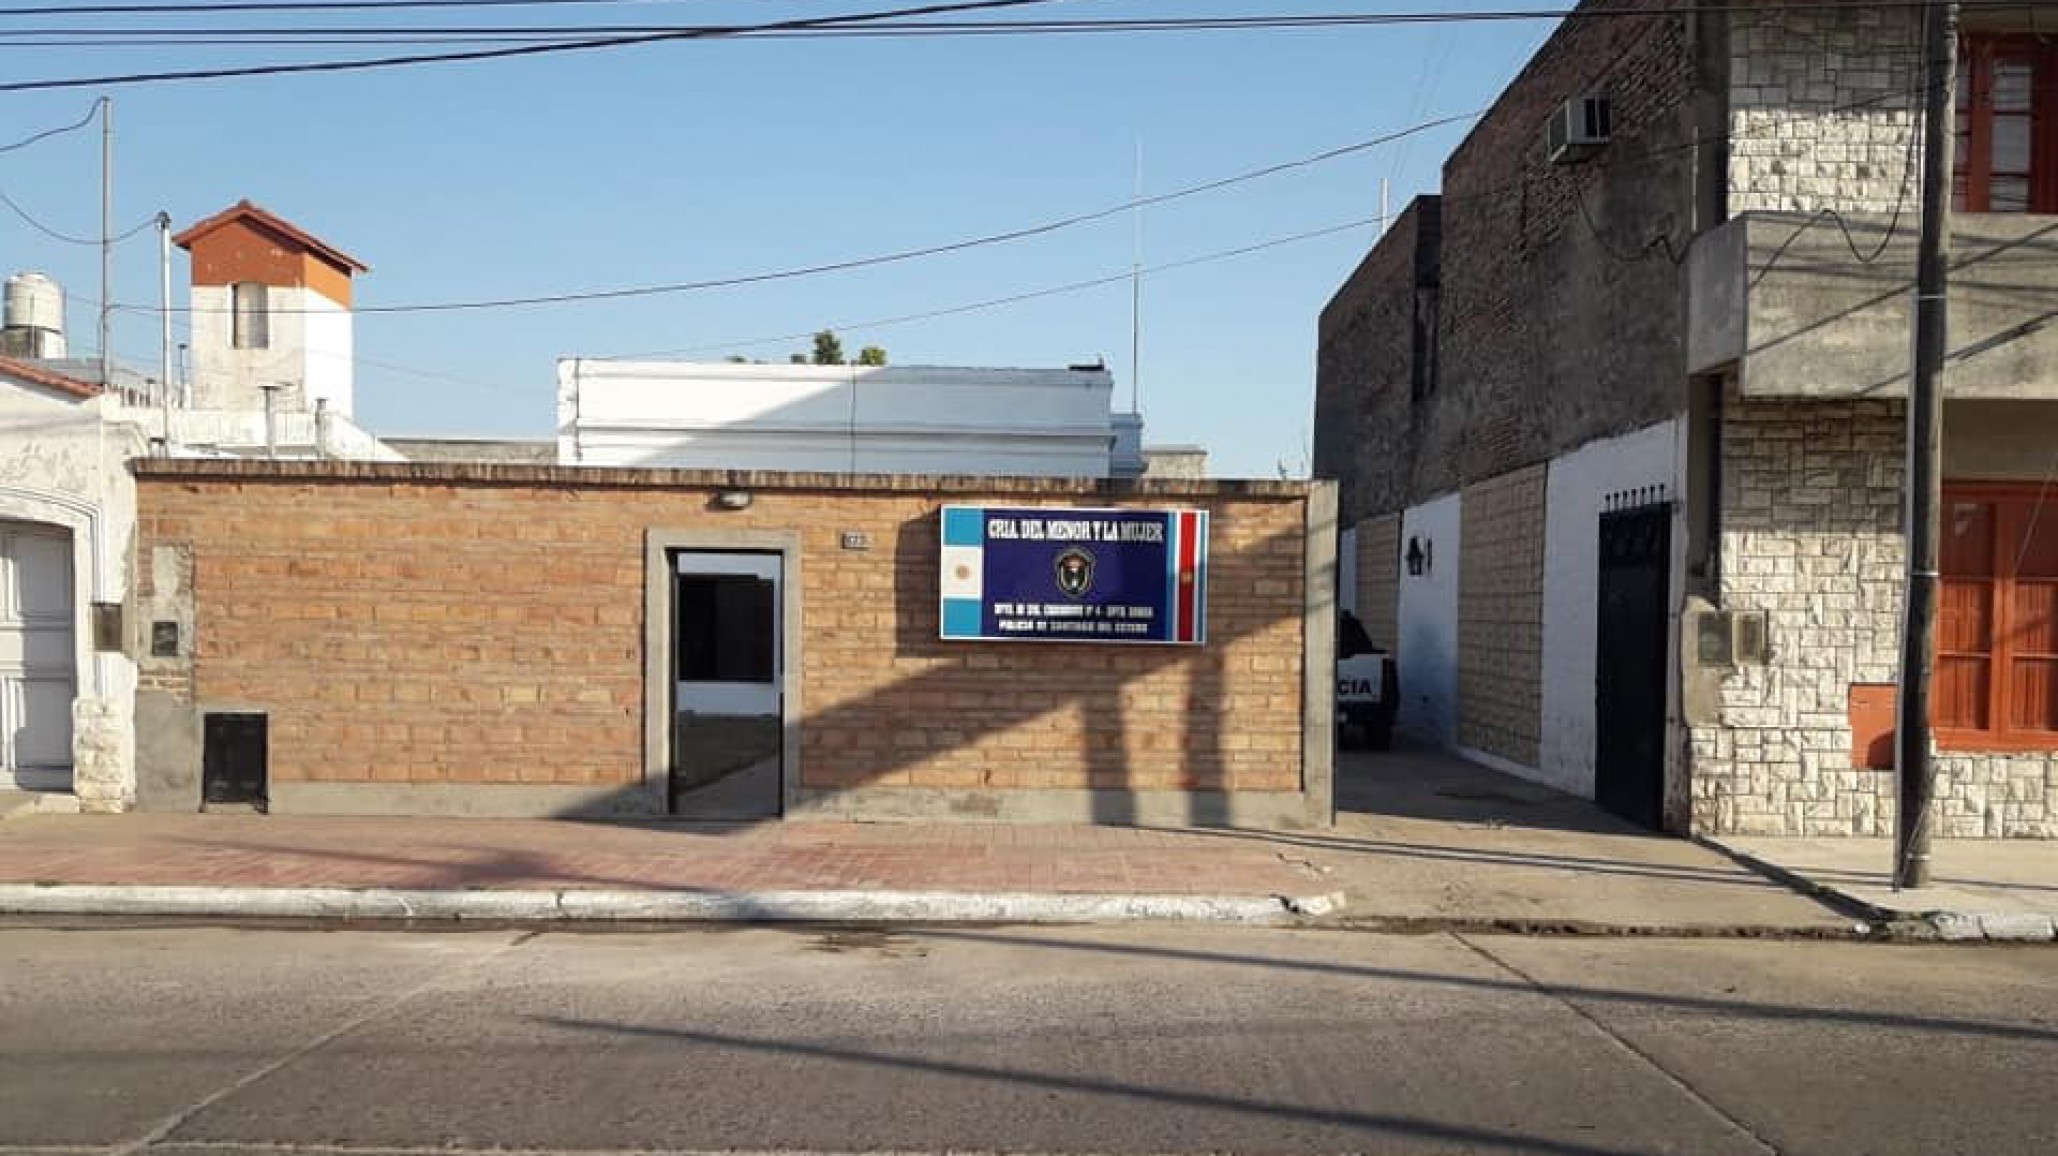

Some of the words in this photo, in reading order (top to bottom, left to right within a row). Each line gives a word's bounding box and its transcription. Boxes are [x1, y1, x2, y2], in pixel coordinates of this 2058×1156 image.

[1021, 519, 1045, 539] DEL
[1047, 520, 1092, 540] MENOR
[1103, 521, 1118, 541] LA
[1120, 522, 1163, 542] MUJER
